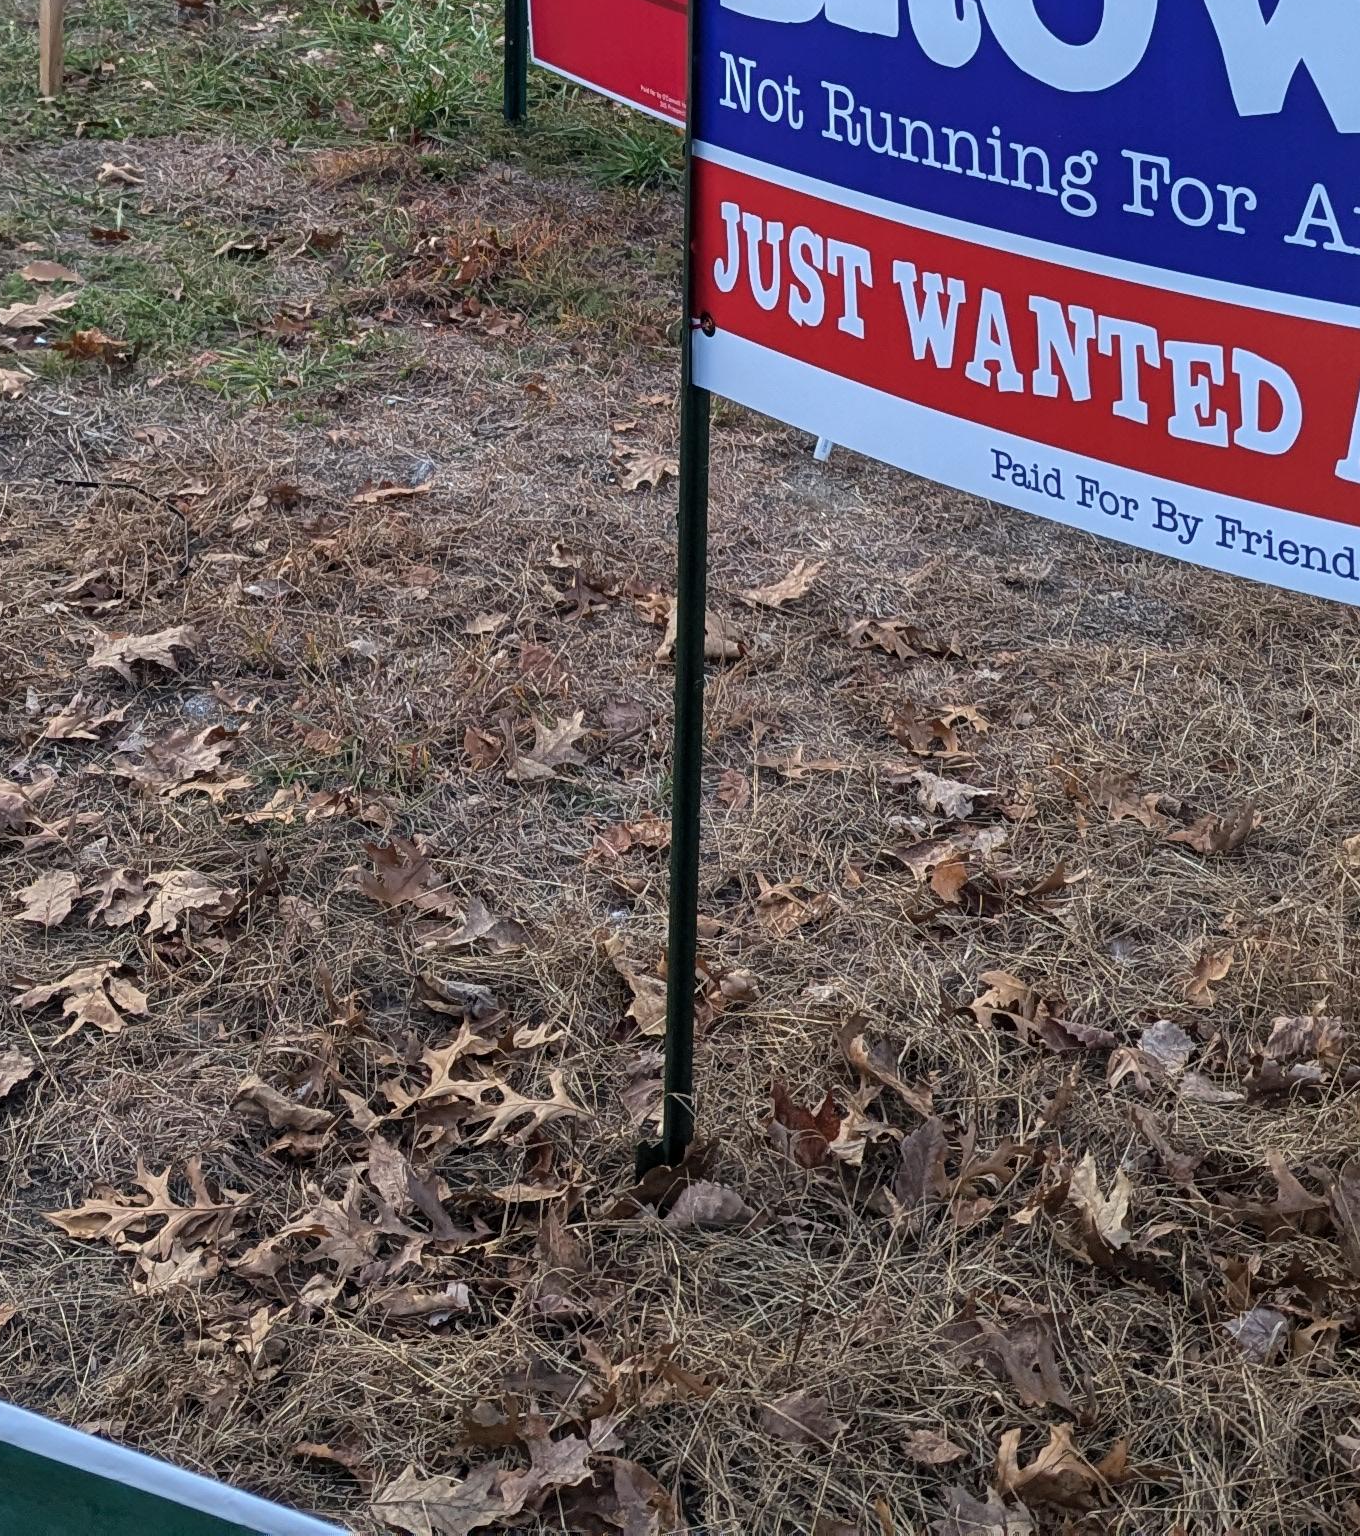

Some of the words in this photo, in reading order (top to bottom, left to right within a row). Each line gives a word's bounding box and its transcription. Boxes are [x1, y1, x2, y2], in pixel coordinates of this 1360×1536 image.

[719, 52, 804, 131] Not
[820, 81, 1098, 218] Running
[1122, 149, 1256, 235] For
[713, 202, 872, 338] JUST
[892, 261, 1303, 457] WANTED
[990, 448, 1065, 500] Paid
[1075, 476, 1139, 521] For
[1152, 497, 1203, 545] By
